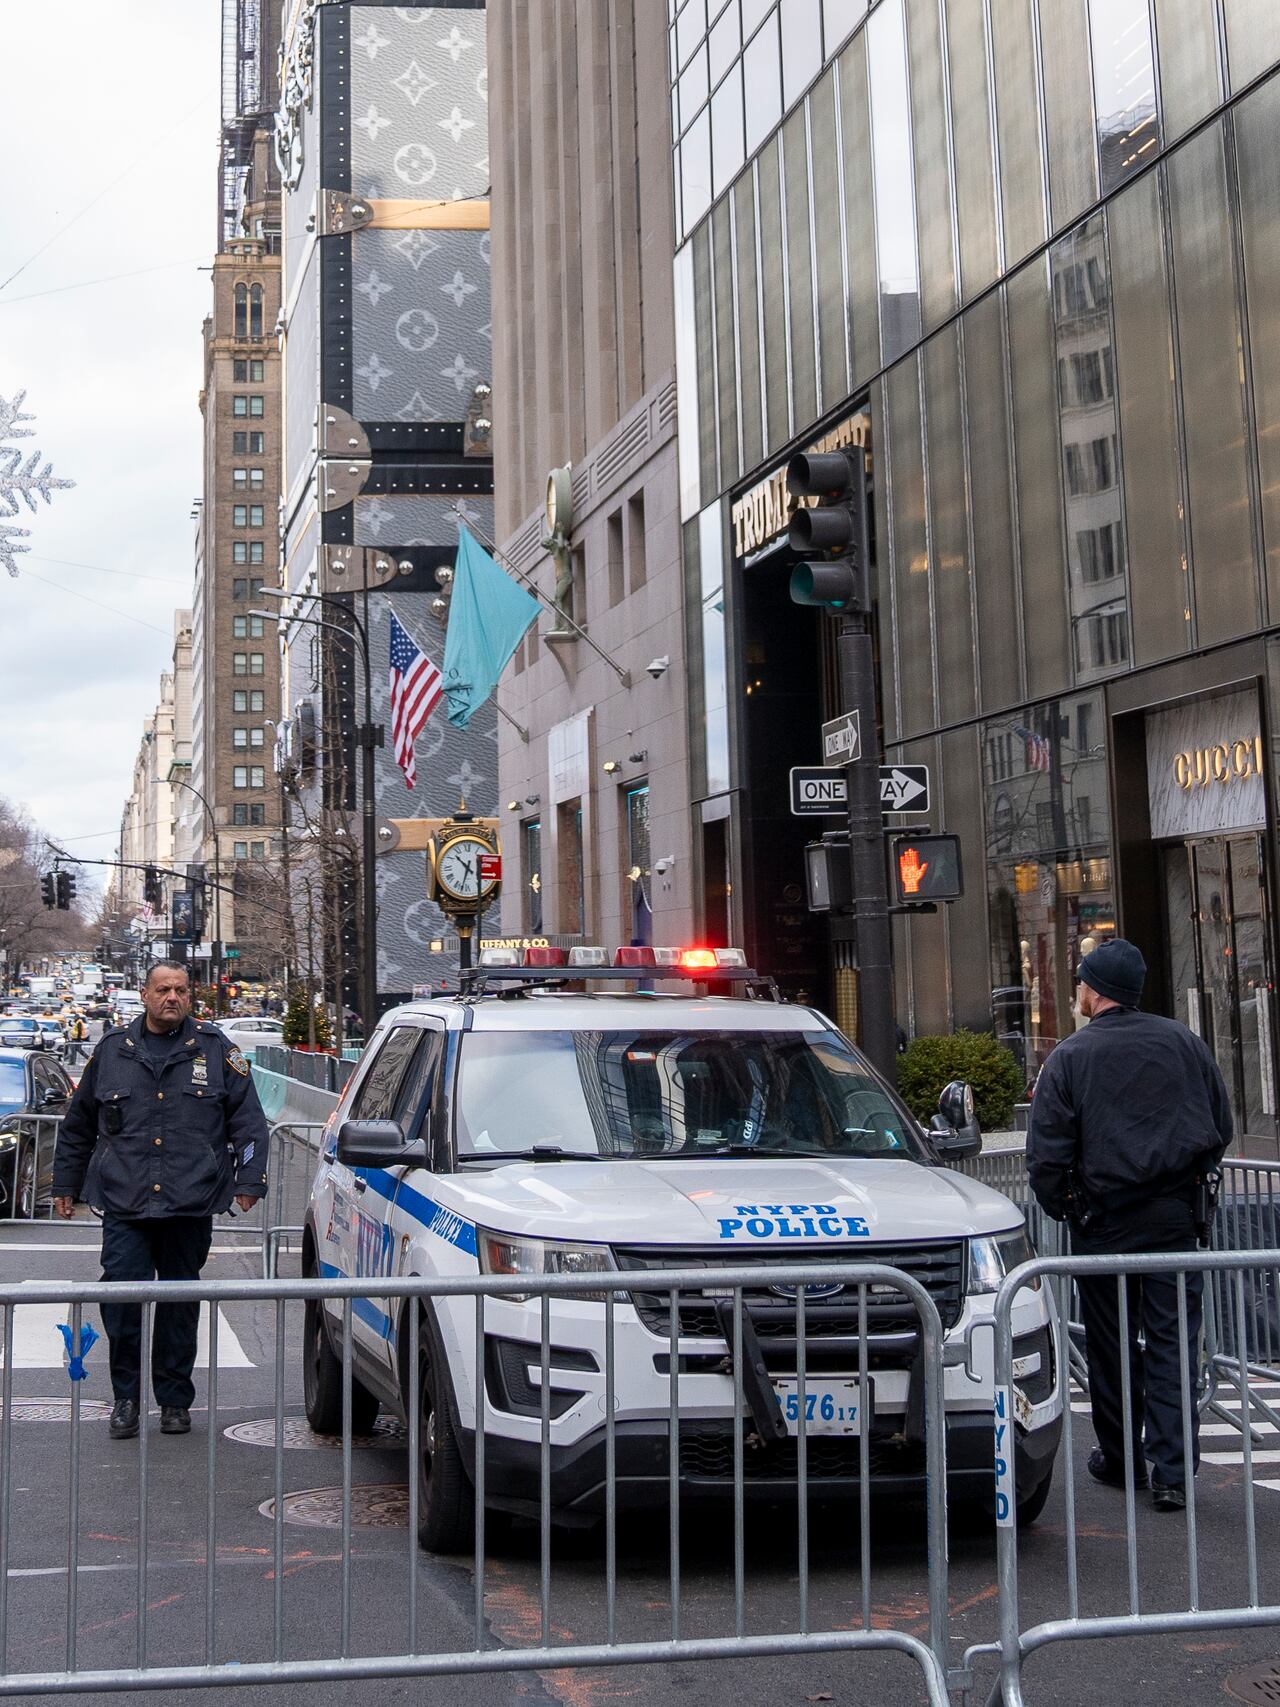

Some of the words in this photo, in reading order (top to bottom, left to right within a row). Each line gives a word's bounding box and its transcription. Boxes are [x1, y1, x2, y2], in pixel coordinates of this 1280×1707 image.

[1173, 737, 1263, 788] GUCCI
[804, 781, 845, 800] ONE
[880, 780, 910, 798] AY
[522, 939, 531, 948] &
[733, 1204, 838, 1216] NYPD
[428, 1206, 465, 1244] POLICE
[717, 1217, 871, 1239] POLICE
[837, 1406, 858, 1421] 17
